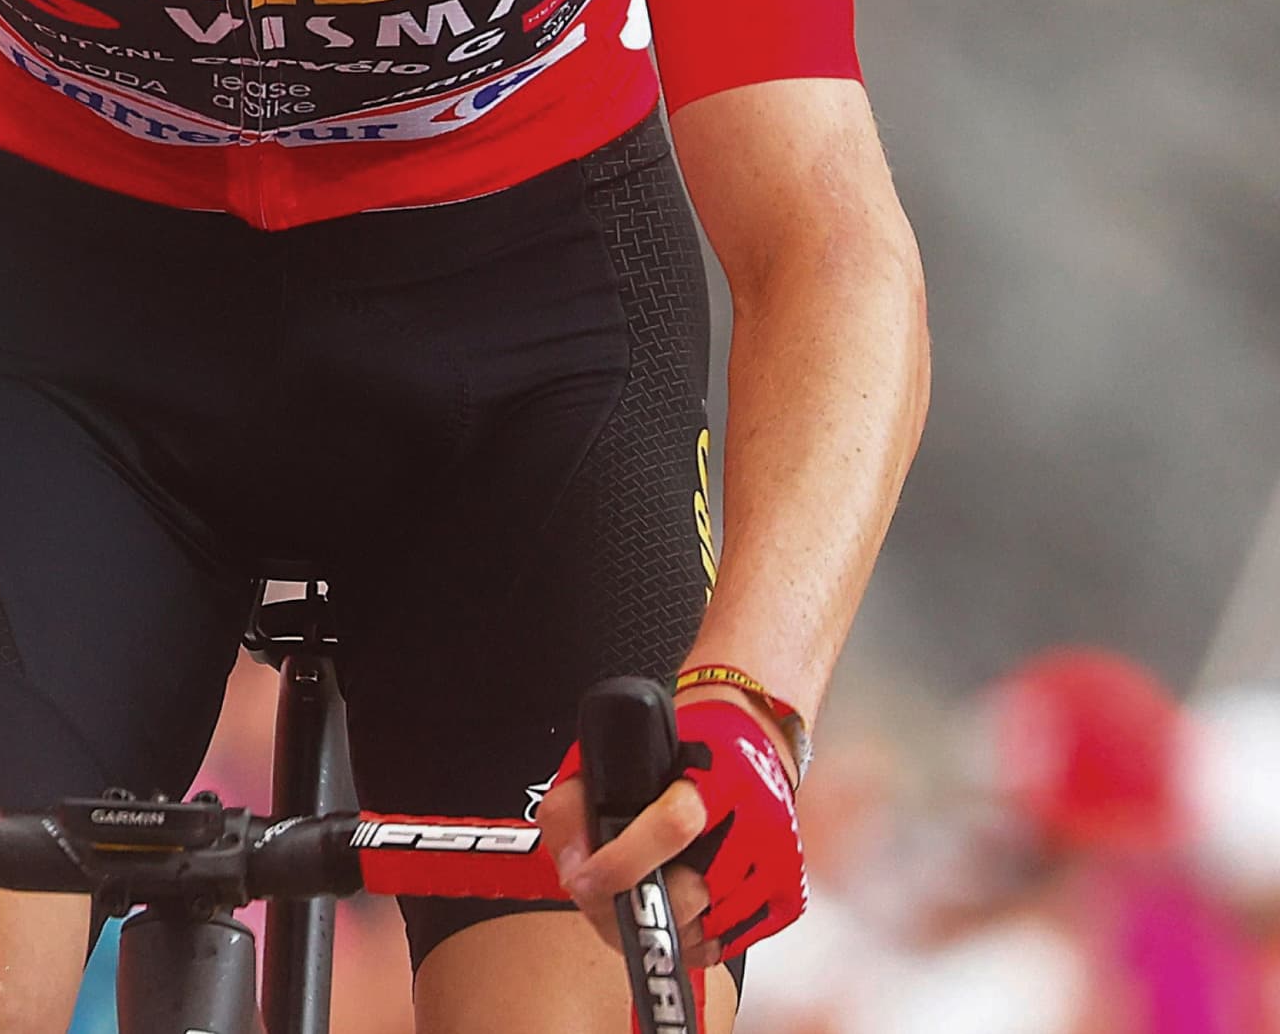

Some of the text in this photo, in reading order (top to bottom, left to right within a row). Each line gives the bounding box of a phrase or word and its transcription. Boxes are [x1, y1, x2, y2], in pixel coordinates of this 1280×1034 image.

[213, 73, 311, 99] lease
[90, 809, 165, 826] GARMIN
[631, 882, 688, 1034] SRA
